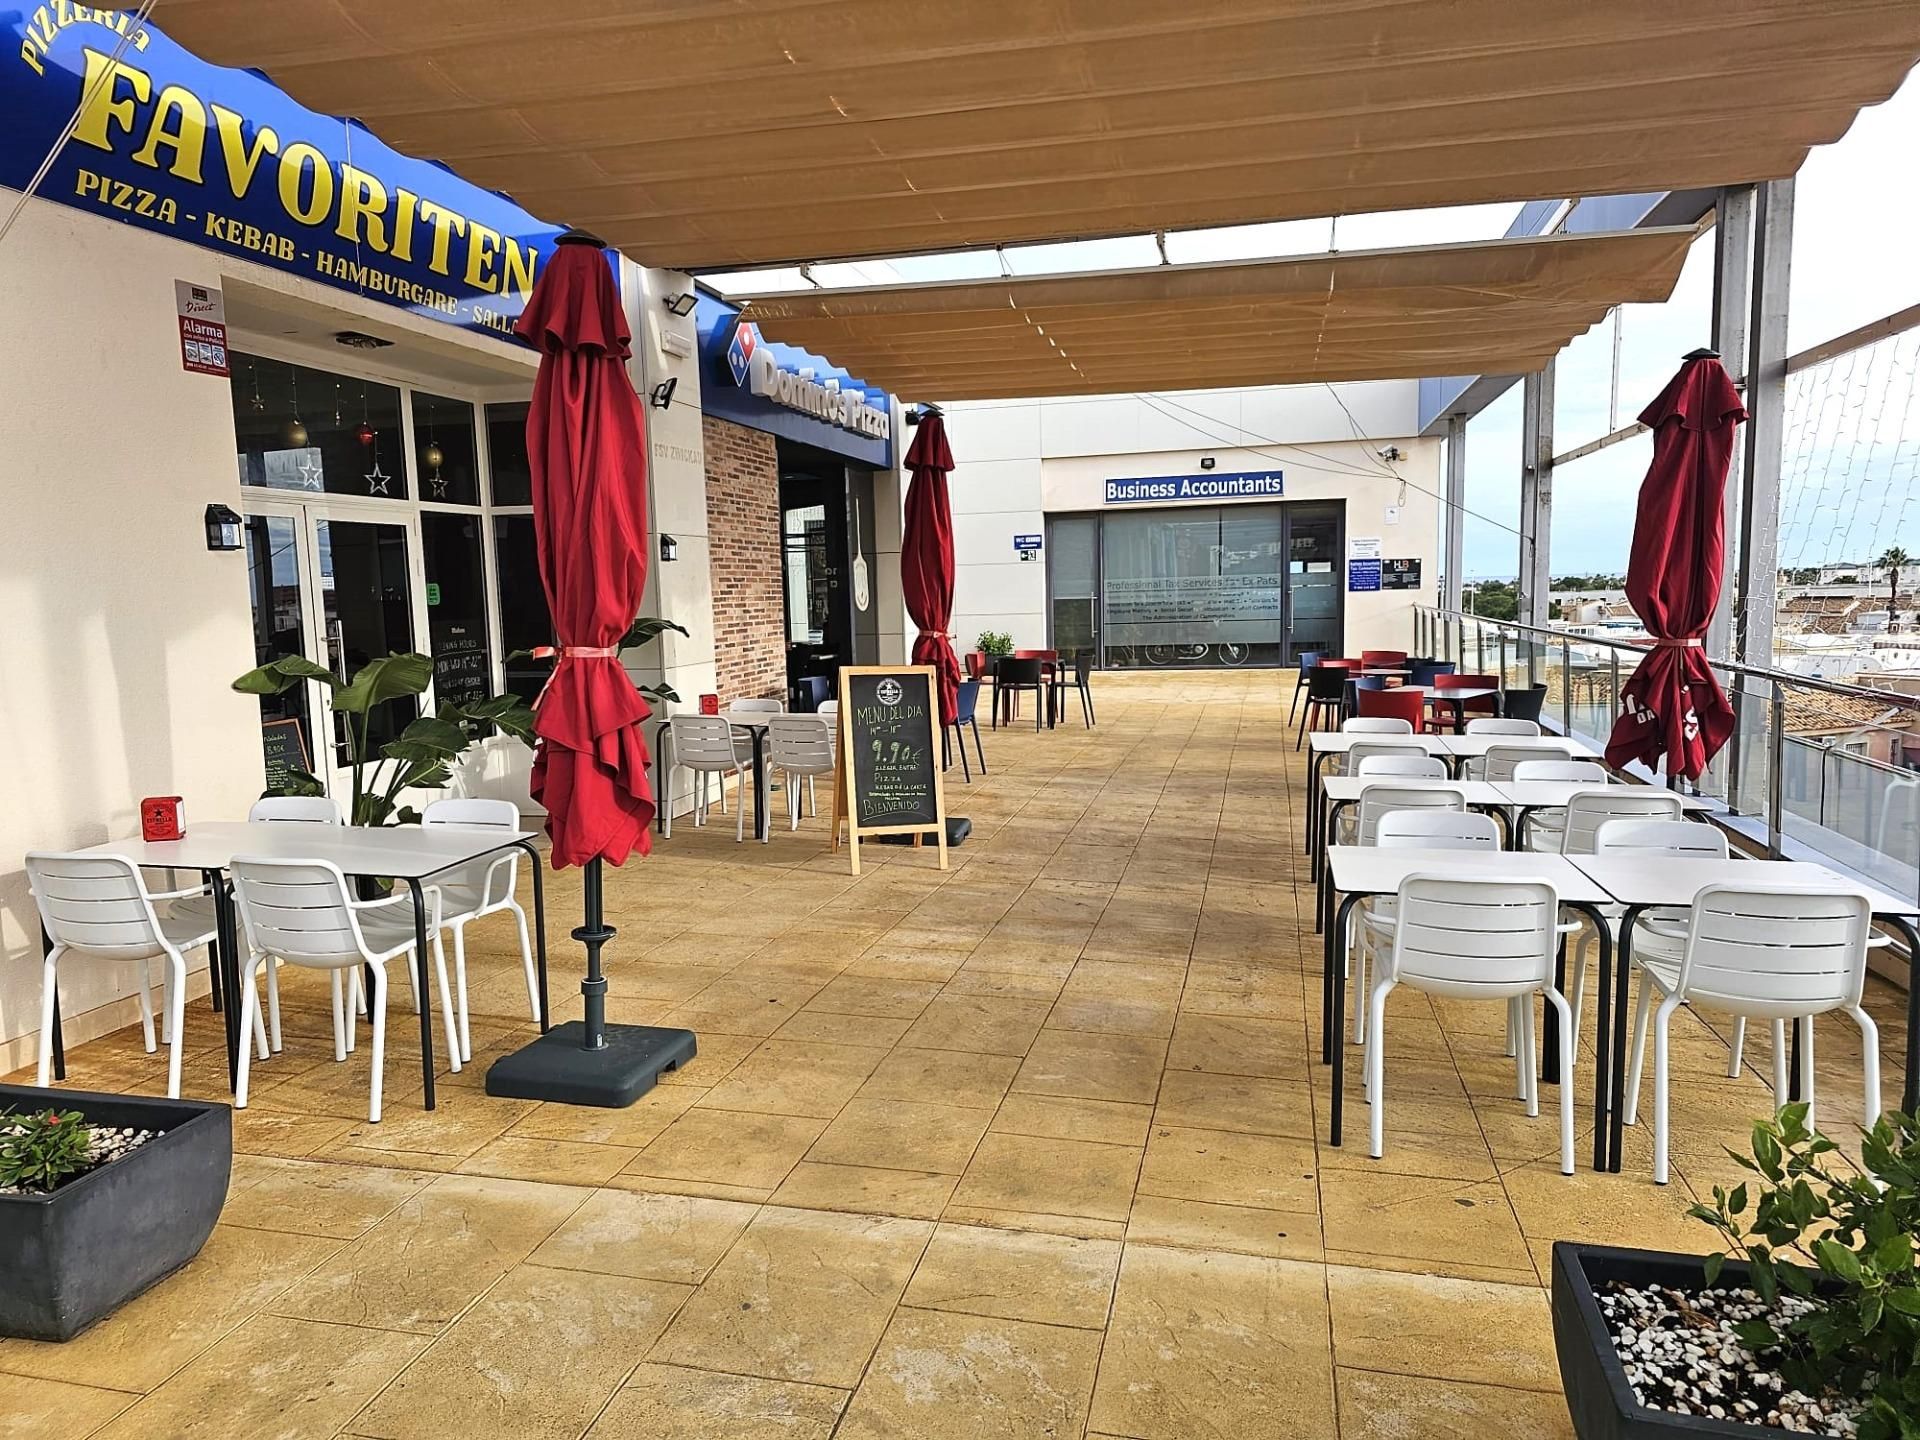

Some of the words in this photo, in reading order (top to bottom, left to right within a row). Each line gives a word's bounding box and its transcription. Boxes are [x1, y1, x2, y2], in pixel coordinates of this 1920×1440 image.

[21, 0, 151, 76] PIZZERIA
[71, 48, 538, 305] FAVORITEN
[75, 168, 178, 226] PIZZA
[205, 211, 296, 262] KEBAB
[316, 251, 458, 316] HAMBURGARE
[183, 320, 223, 339] Alarma
[841, 388, 889, 440] Pizza
[1107, 481, 1176, 499] Business
[1180, 475, 1282, 496] Accountants
[1106, 581, 1160, 591] Professional
[1182, 578, 1222, 587] Services
[857, 705, 887, 726] MENU
[889, 705, 904, 720] DEL
[907, 704, 923, 718] DIA
[864, 799, 920, 816] BIENVENIDO
